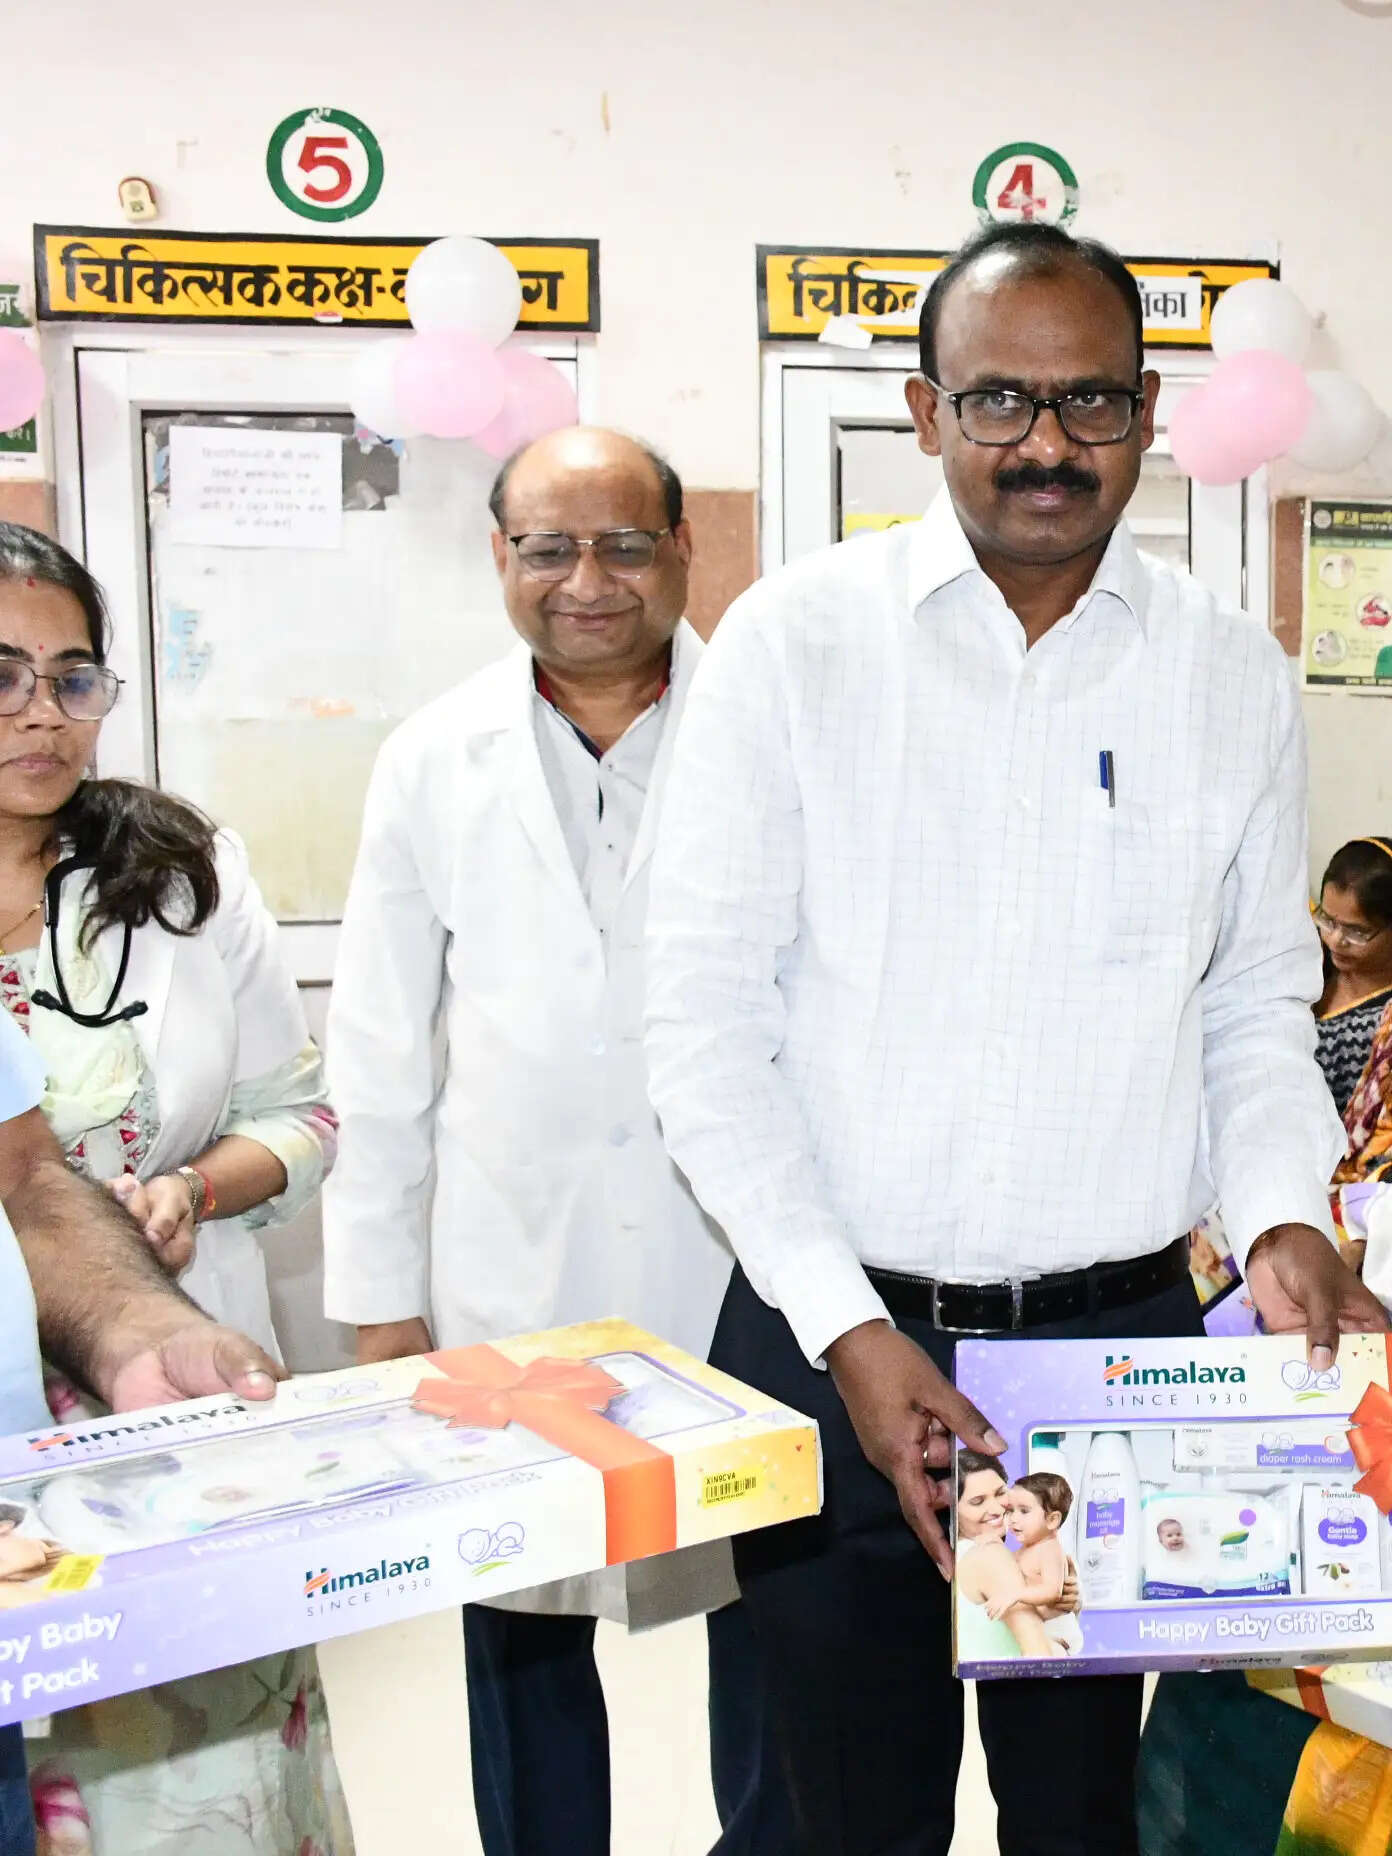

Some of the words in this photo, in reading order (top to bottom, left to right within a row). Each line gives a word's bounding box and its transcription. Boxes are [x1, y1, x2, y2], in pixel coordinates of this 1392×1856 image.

[298, 136, 353, 203] 5
[997, 164, 1047, 222] 4
[60, 242, 281, 307] चिकित्सक
[1104, 1355, 1246, 1386] Himalaya
[1106, 1393, 1178, 1407] SINCE
[1196, 1393, 1248, 1405] 1930
[28, 1404, 248, 1452] Himalaya
[1259, 1454, 1288, 1465] diaper
[1291, 1454, 1311, 1464] rash
[1313, 1455, 1342, 1464] cream
[303, 1553, 431, 1599] Himalaya
[306, 1591, 373, 1618] SINCE
[386, 1578, 432, 1599] 1930
[41, 1611, 124, 1650] Baby
[1138, 1618, 1210, 1644] Happy
[1215, 1612, 1270, 1641] Baby
[1274, 1610, 1318, 1638] Gift
[1321, 1608, 1375, 1633] Pack
[22, 1656, 99, 1700] Pack
